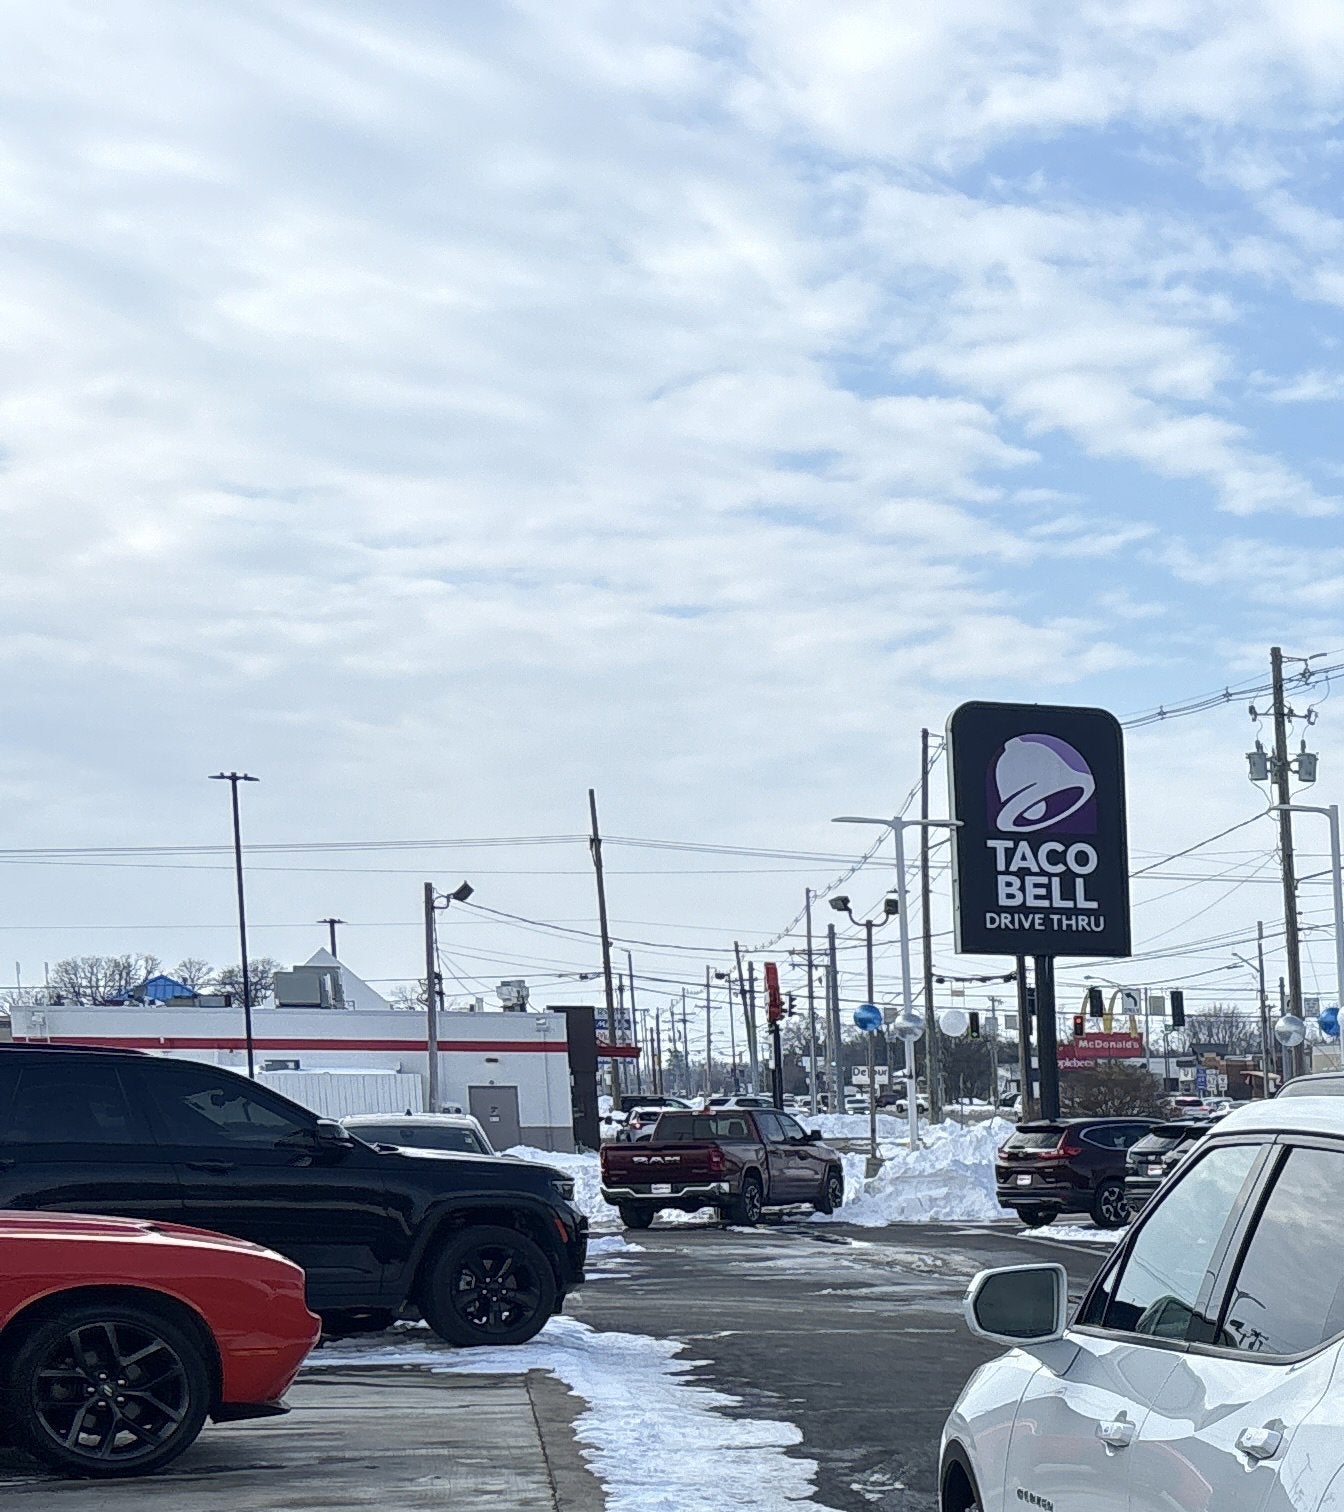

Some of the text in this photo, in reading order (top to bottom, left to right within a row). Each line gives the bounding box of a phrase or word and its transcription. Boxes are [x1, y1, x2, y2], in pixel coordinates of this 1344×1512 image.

[986, 839, 1098, 875] TACO
[997, 875, 1099, 910] BELL
[985, 913, 1105, 932] DRIVE THRU
[1078, 1039, 1140, 1049] McDonald's
